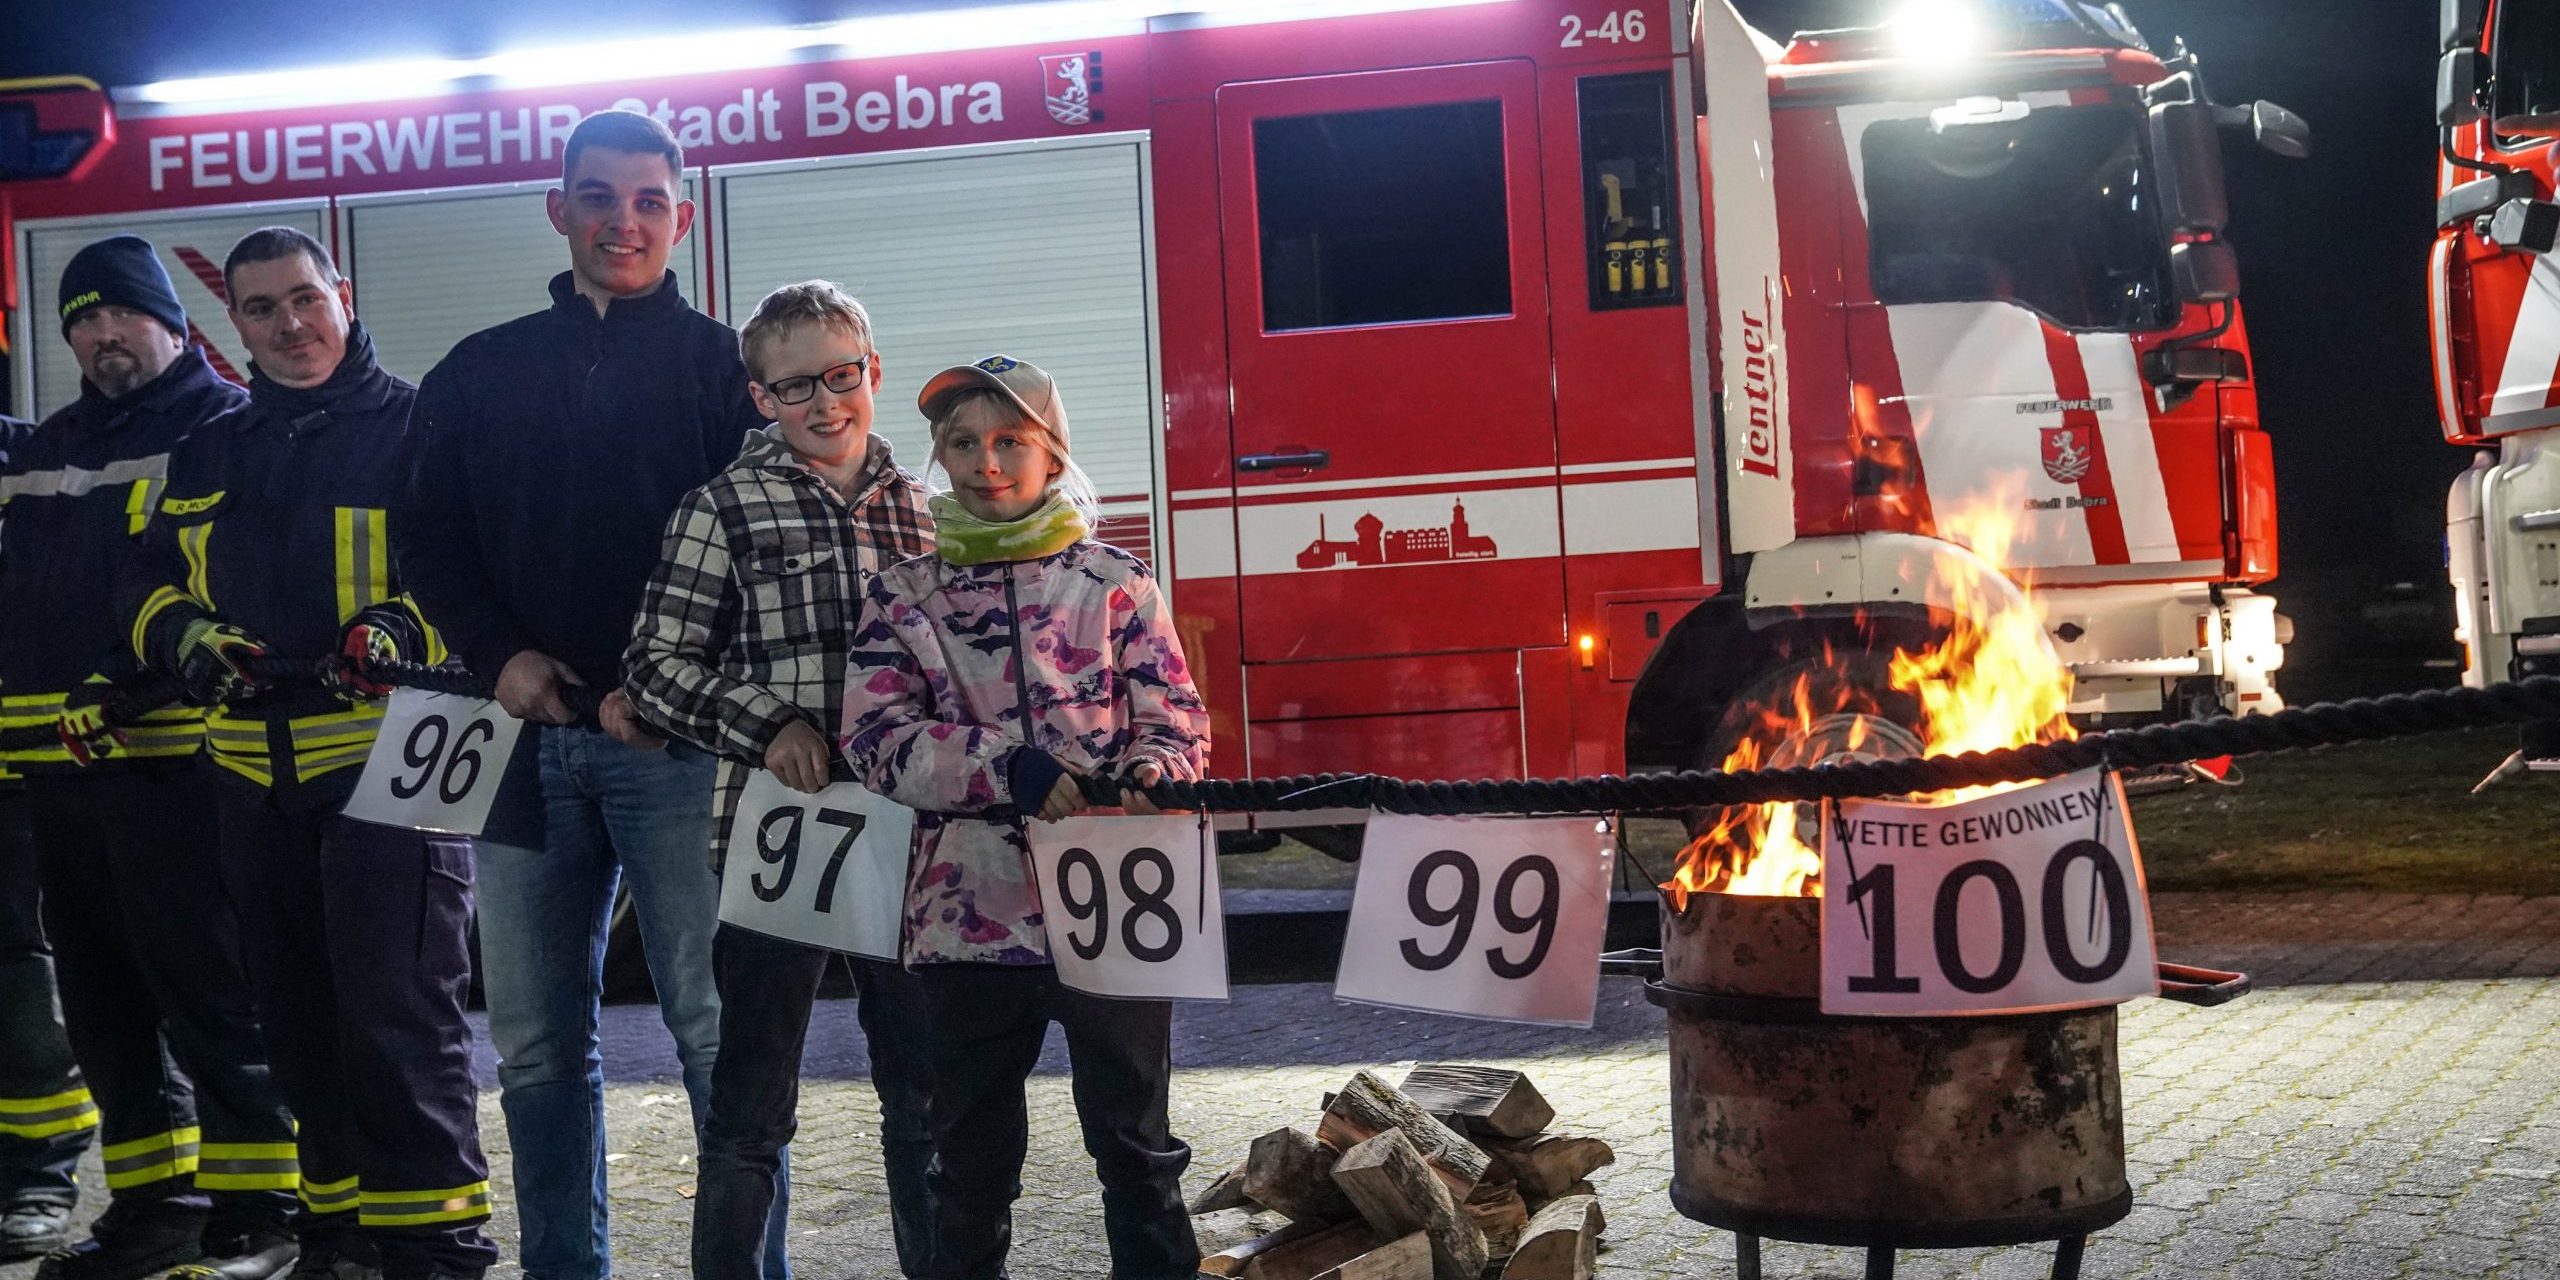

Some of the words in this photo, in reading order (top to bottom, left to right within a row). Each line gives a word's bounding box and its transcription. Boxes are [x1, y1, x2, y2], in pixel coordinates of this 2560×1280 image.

[1559, 9, 1646, 48] 2-46
[150, 104, 582, 191] FEUERWEHR
[611, 88, 783, 149] tadt
[804, 75, 1004, 138] Bebra
[1740, 308, 1779, 479] Lentner
[2016, 397, 2114, 414] FEUERWEHR
[390, 714, 495, 805] 96
[750, 805, 866, 914] 97
[1834, 816, 1928, 848] WETTE
[1056, 847, 1184, 963] 98
[1399, 849, 1562, 981] 99
[1846, 838, 2131, 994] 100
